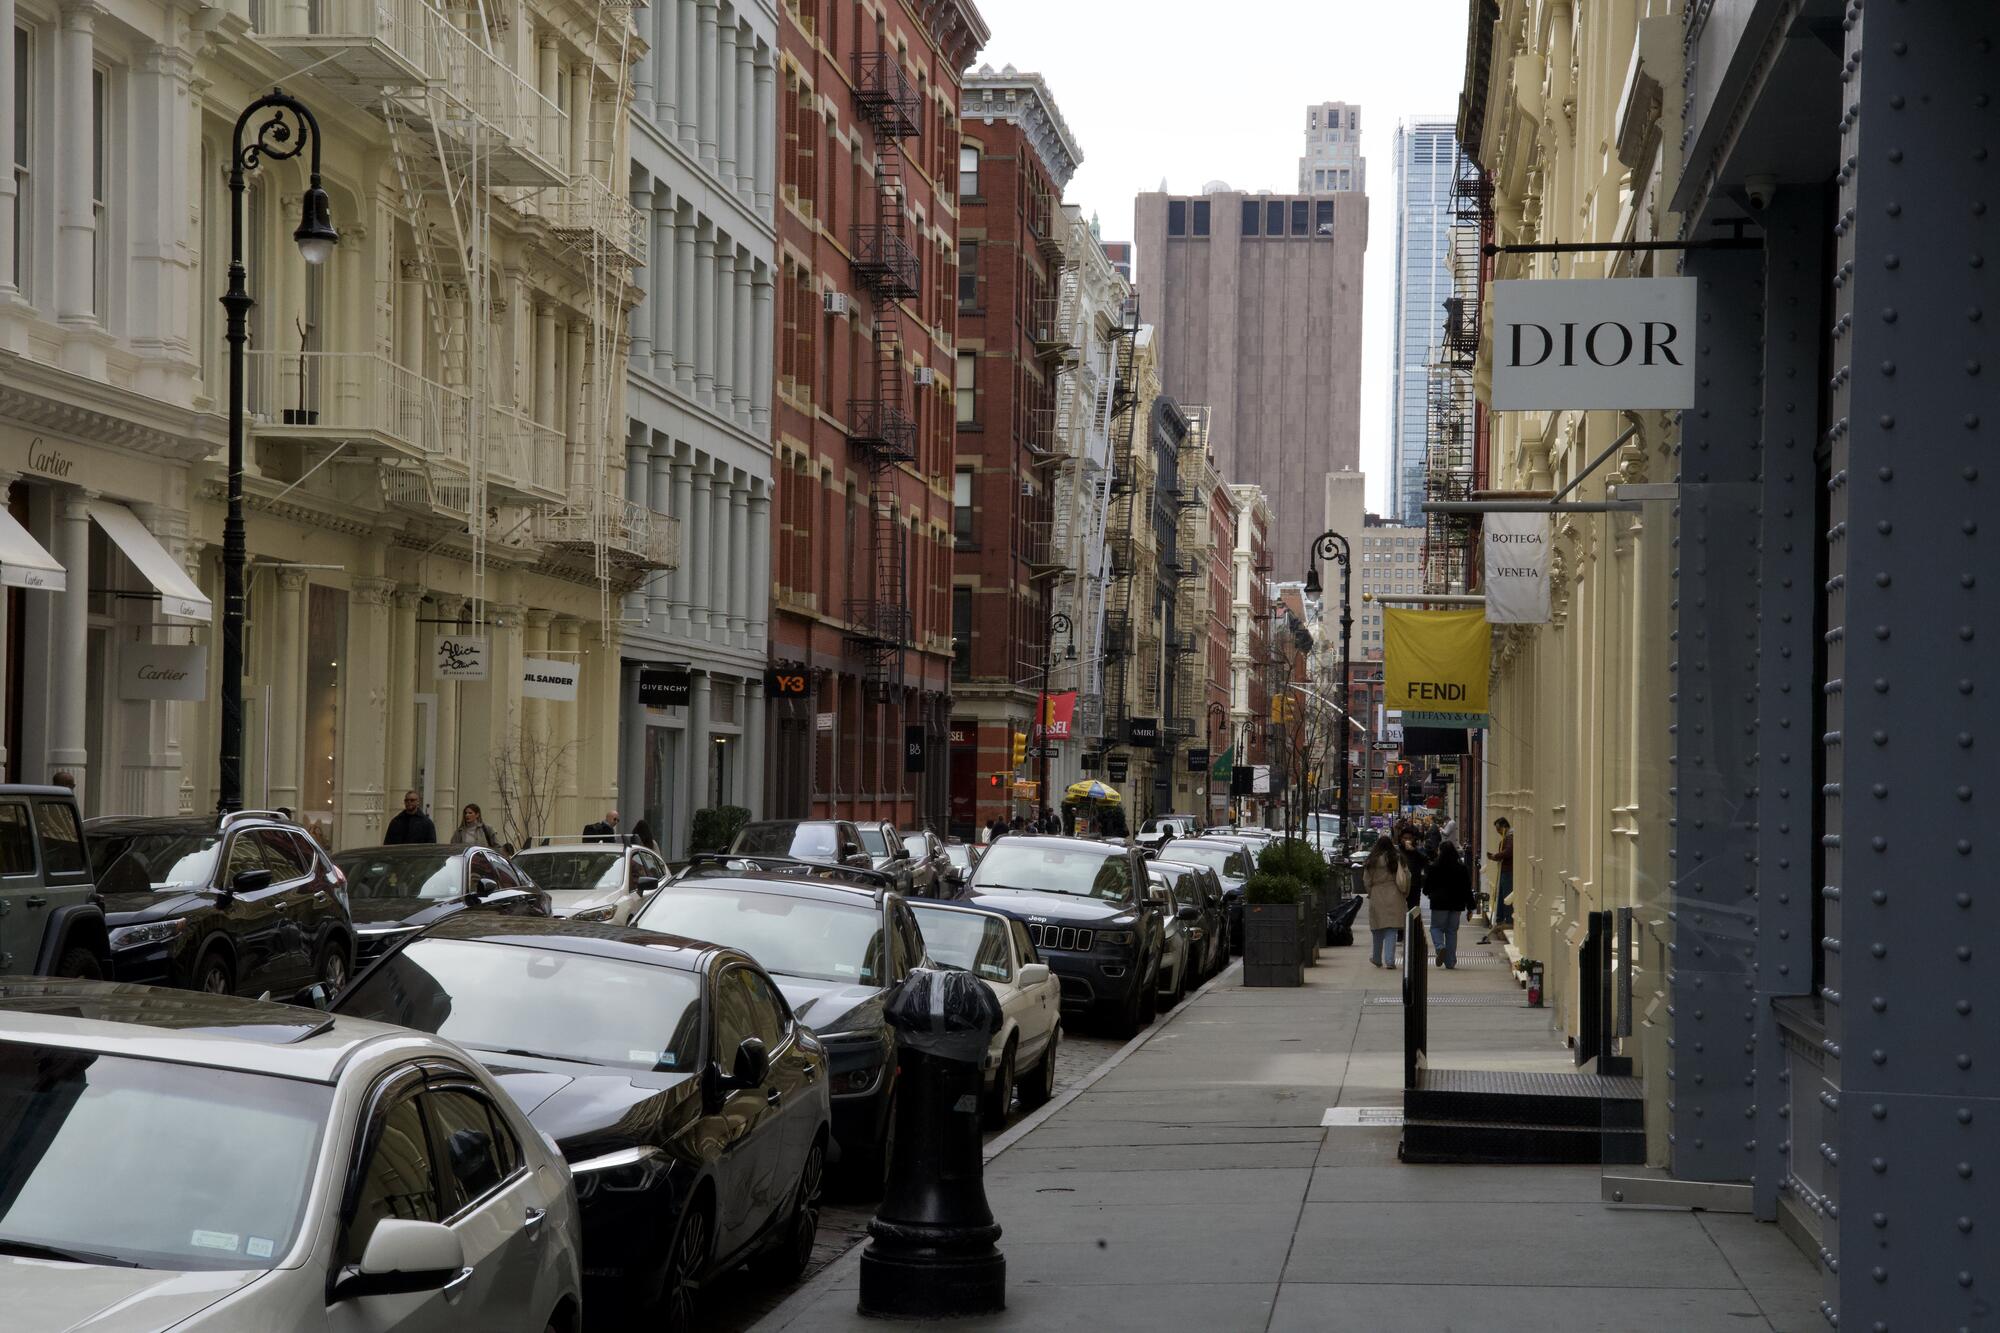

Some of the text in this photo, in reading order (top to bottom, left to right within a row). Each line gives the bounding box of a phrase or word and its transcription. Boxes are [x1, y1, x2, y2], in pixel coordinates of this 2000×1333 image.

[1506, 321, 1684, 367] DIOR
[28, 437, 73, 477] Cartier
[1492, 533, 1542, 544] BOTTEGA
[24, 572, 44, 586] Cartier
[1497, 567, 1538, 578] VENETA
[180, 602, 196, 616] Cartier
[438, 640, 480, 661] Alice
[137, 664, 189, 682] Cartier
[524, 673, 573, 686] JIL SANDER
[641, 683, 688, 692] GIVENCHY
[776, 674, 805, 692] Y-3
[1407, 682, 1467, 701] FENDI
[1454, 713, 1463, 721] &
[1131, 729, 1155, 737] AMIRI
[1028, 915, 1047, 923] Jeep
